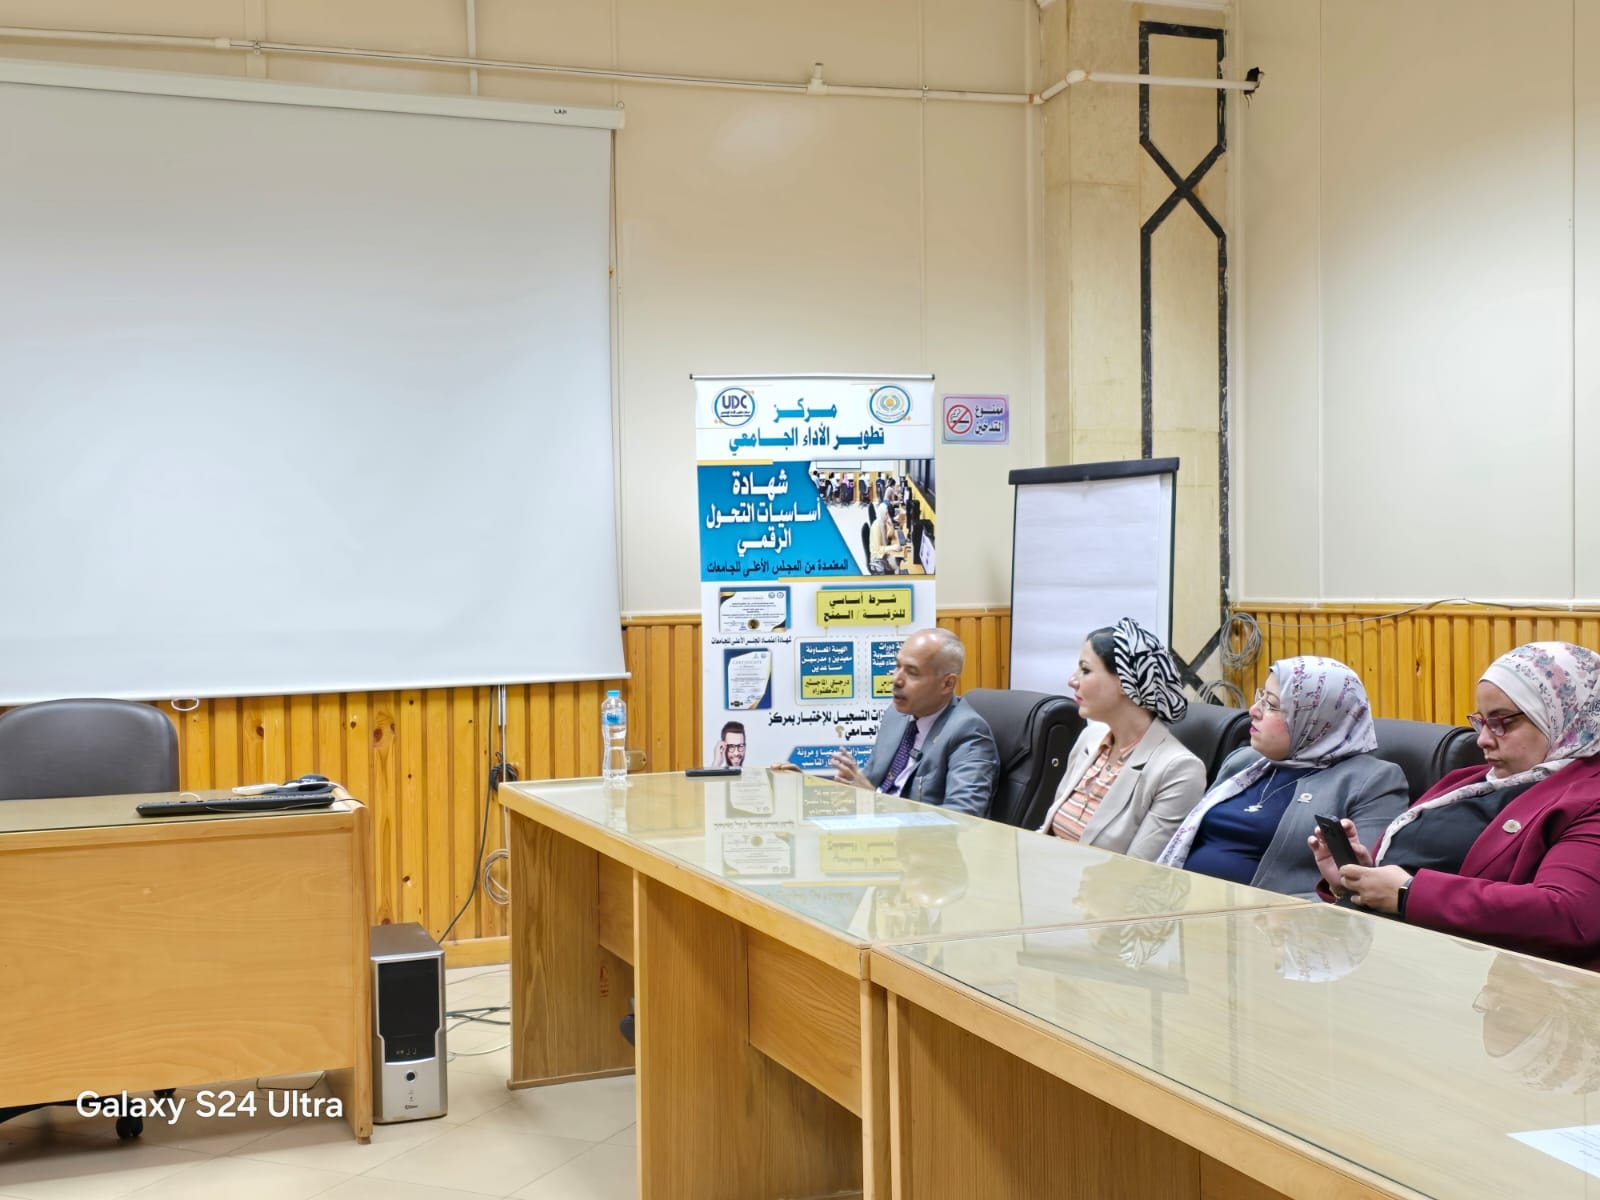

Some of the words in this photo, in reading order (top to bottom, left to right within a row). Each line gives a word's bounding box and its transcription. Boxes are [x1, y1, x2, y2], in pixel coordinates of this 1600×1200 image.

[722, 395, 747, 409] UDC
[773, 398, 837, 423] مركز
[802, 422, 830, 446] الأداء
[975, 421, 1003, 435] التدخين
[728, 427, 798, 456] الجامعي
[833, 425, 885, 450] تطوير
[732, 468, 789, 500] شهادة
[706, 502, 755, 528] التحول
[756, 497, 821, 527] أساسيات
[737, 525, 791, 557] الرقمي
[706, 561, 741, 576] للجامعات
[772, 560, 802, 575] المجلس
[805, 564, 816, 575] من
[818, 559, 849, 571] المعتمدة
[829, 592, 864, 609] أساسي
[868, 594, 897, 606] شرط
[824, 610, 853, 622] المنح
[862, 609, 906, 621] للترقية
[768, 712, 796, 726] بمركز
[833, 709, 870, 724] التسجيل
